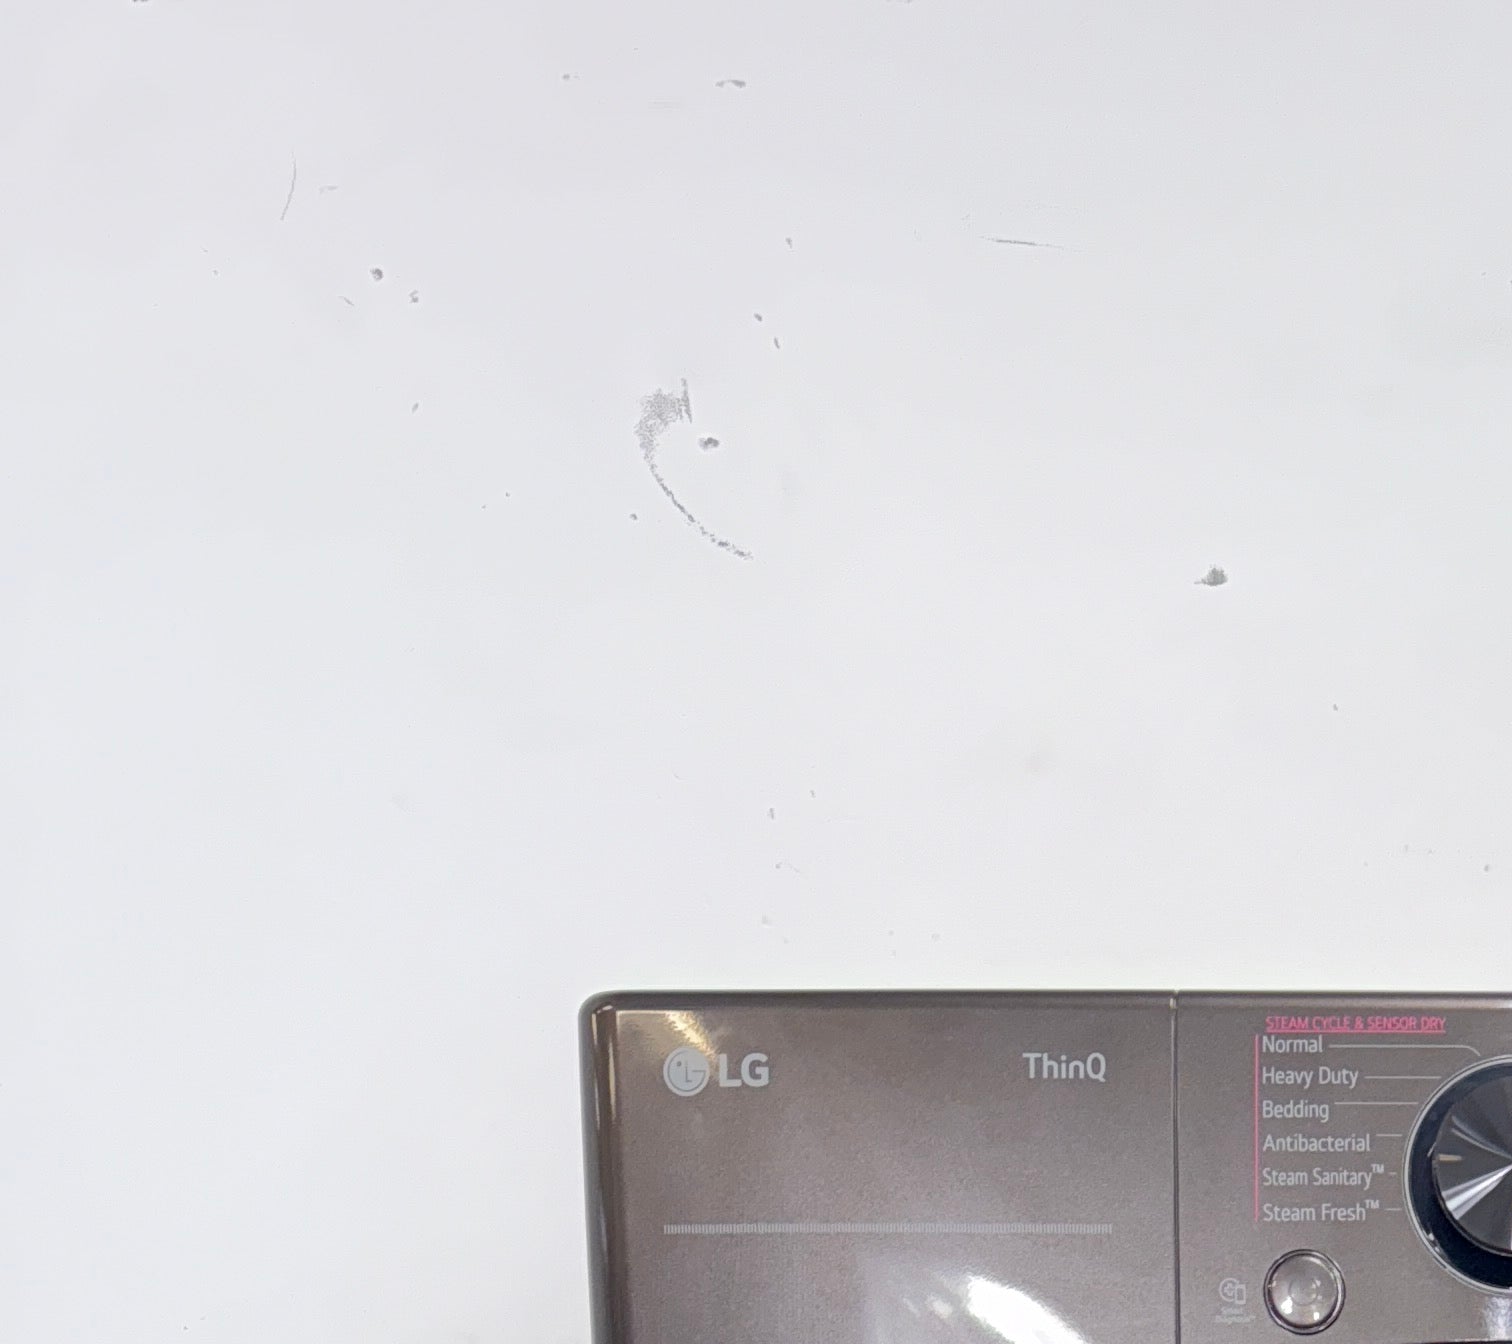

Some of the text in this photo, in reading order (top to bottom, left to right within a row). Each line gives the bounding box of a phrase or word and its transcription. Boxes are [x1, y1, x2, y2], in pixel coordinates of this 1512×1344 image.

[1266, 1017, 1446, 1030] STEAM CYCLE & SENSOR DRY
[1262, 1035, 1323, 1053] Normal
[718, 1053, 770, 1087] LG
[1022, 1052, 1106, 1083] ThinQ
[1262, 1067, 1359, 1089] Heavy Duty
[1262, 1100, 1329, 1123] Bedding
[1263, 1133, 1370, 1151] Antibacterial
[1262, 1167, 1308, 1186] Steam
[1263, 1203, 1316, 1221] Steam
